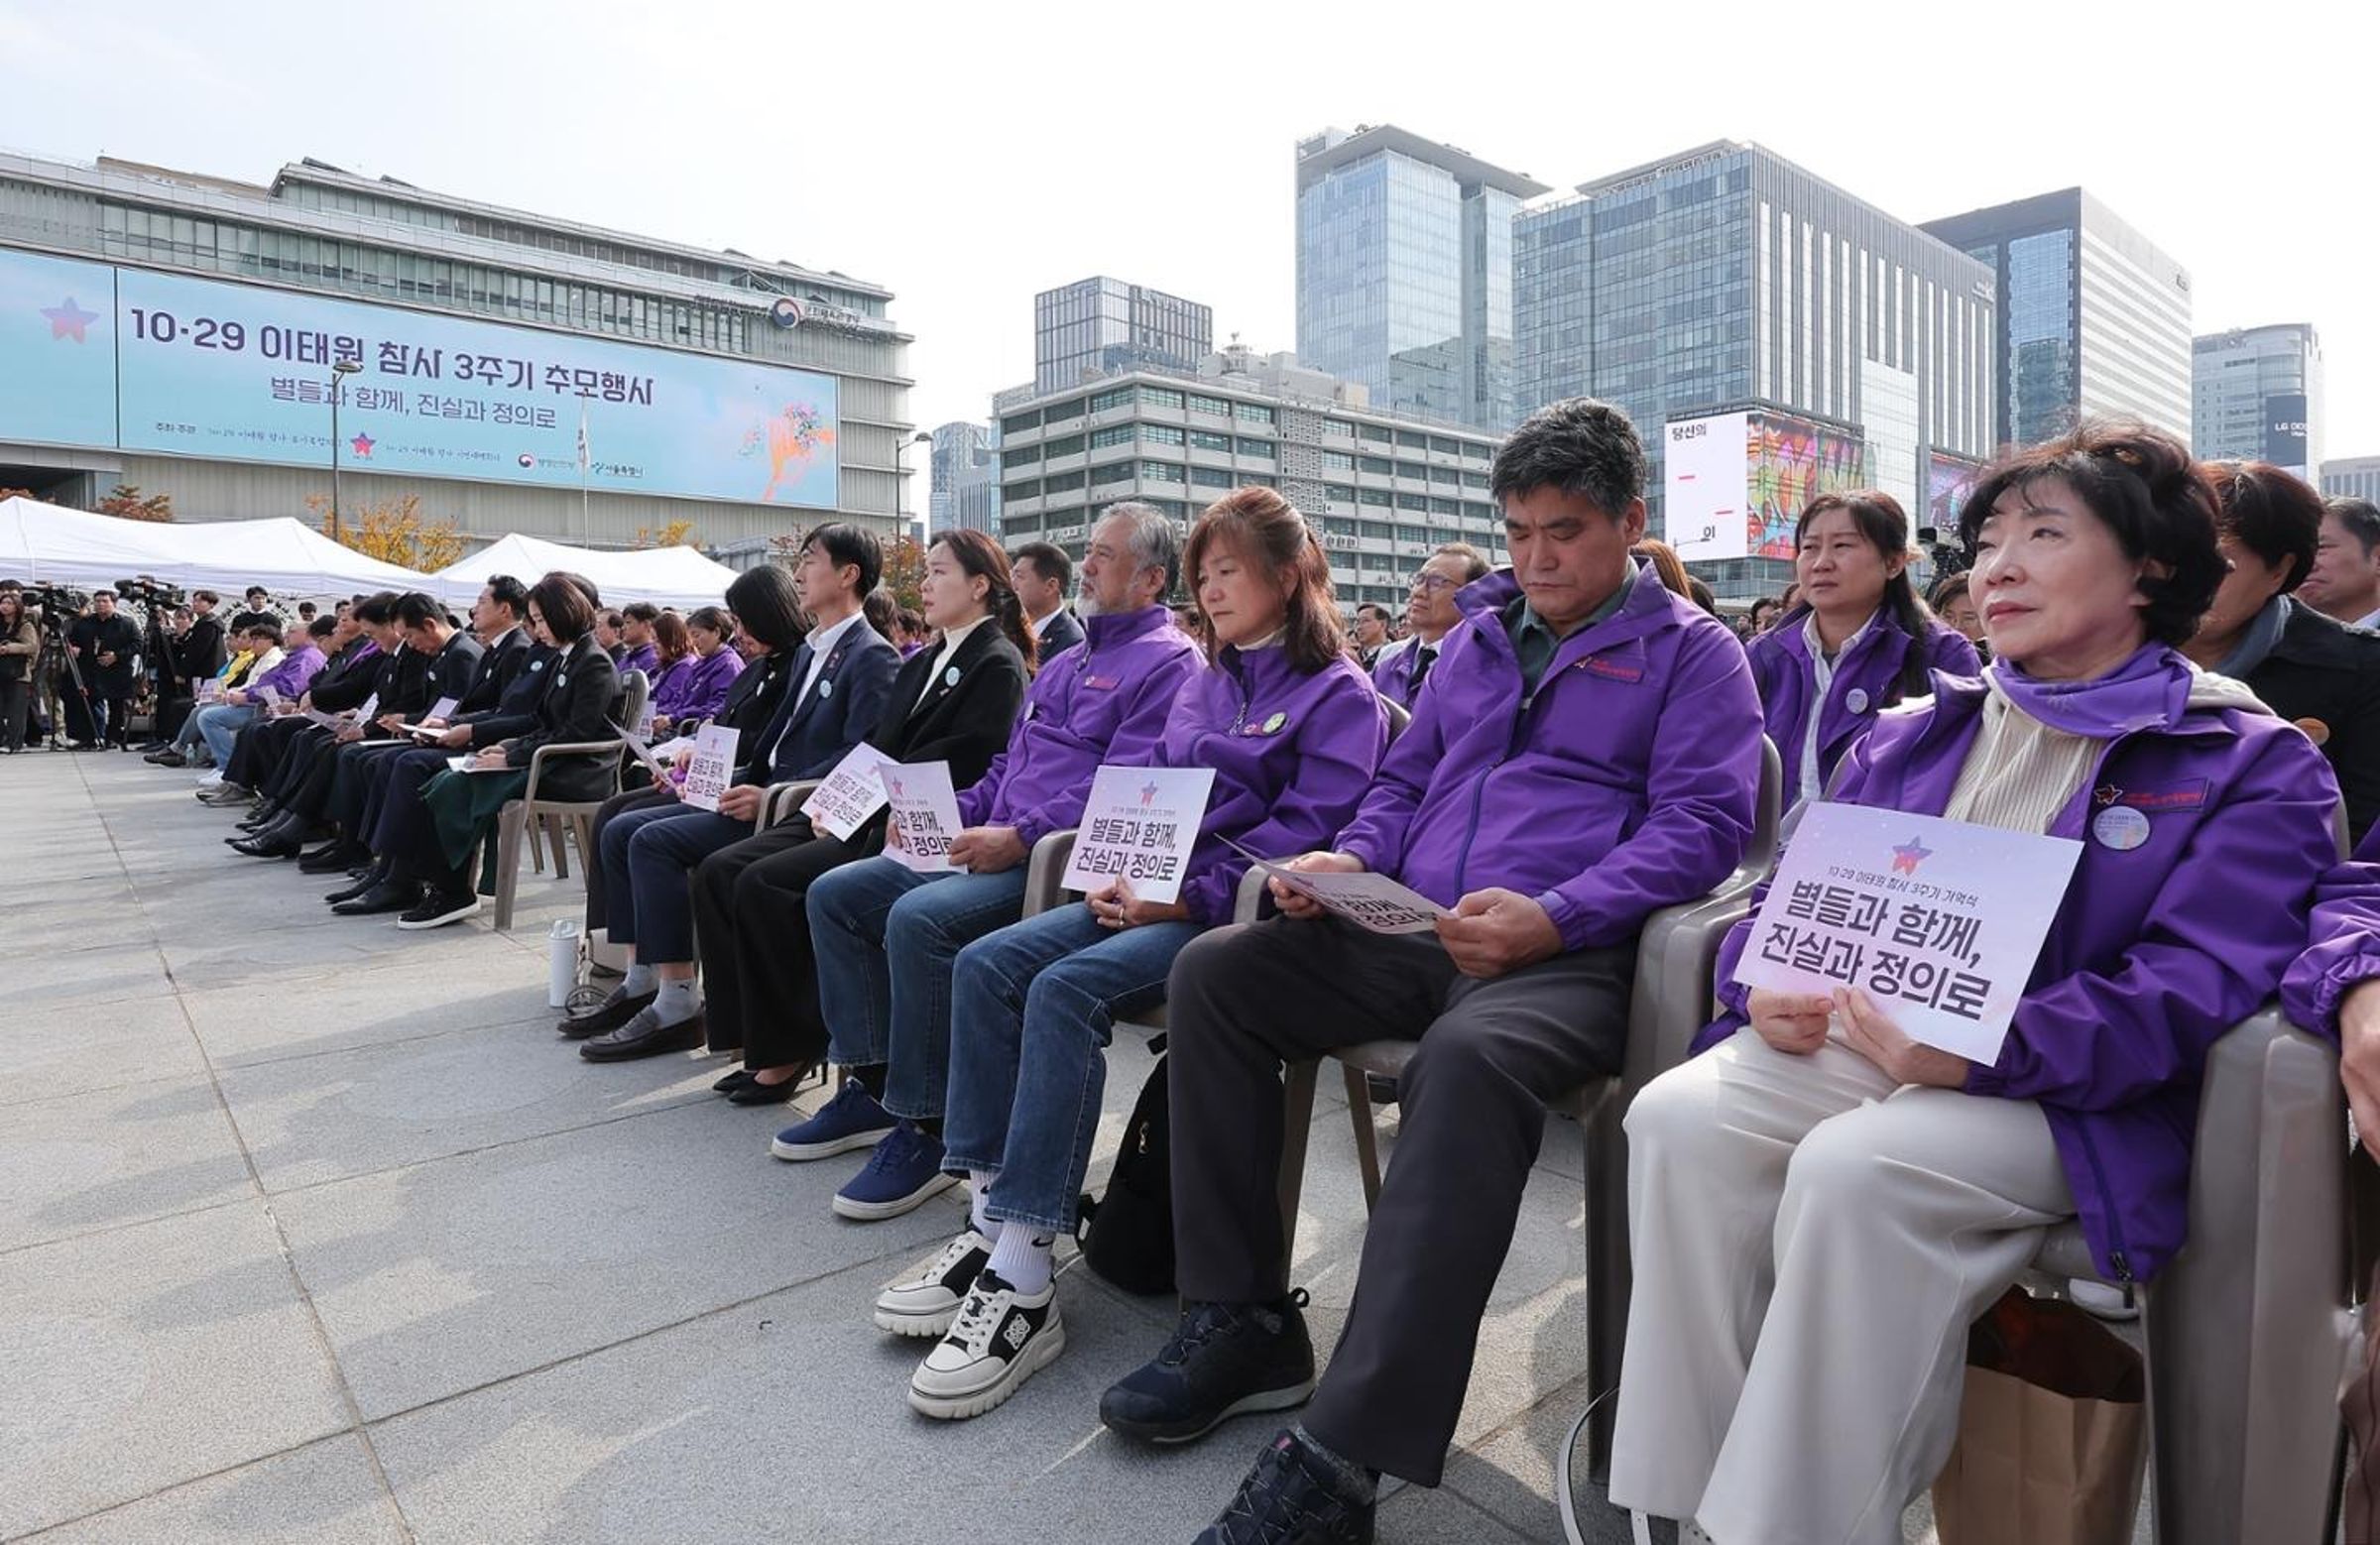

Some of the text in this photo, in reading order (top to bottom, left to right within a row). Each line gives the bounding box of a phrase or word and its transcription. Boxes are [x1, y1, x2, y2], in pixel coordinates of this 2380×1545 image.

[131, 308, 654, 406] 10·29 이태원 참사 3주기 추모행사
[272, 377, 555, 428] 별들과 함께, 진실과 정의로
[1673, 423, 1707, 440] 당신의
[908, 811, 944, 834] 함께,
[1090, 817, 1177, 854] 별들과 함께,
[1076, 847, 1179, 882] 진실과 정의로
[1855, 872, 1885, 888] 이태원
[1886, 877, 1910, 893] 참사
[1911, 883, 1940, 901] 3주기
[1943, 889, 1978, 908] 기억식
[1786, 880, 1982, 969] 별들과 함께,
[1761, 922, 1992, 1021] 진실과 정의로
